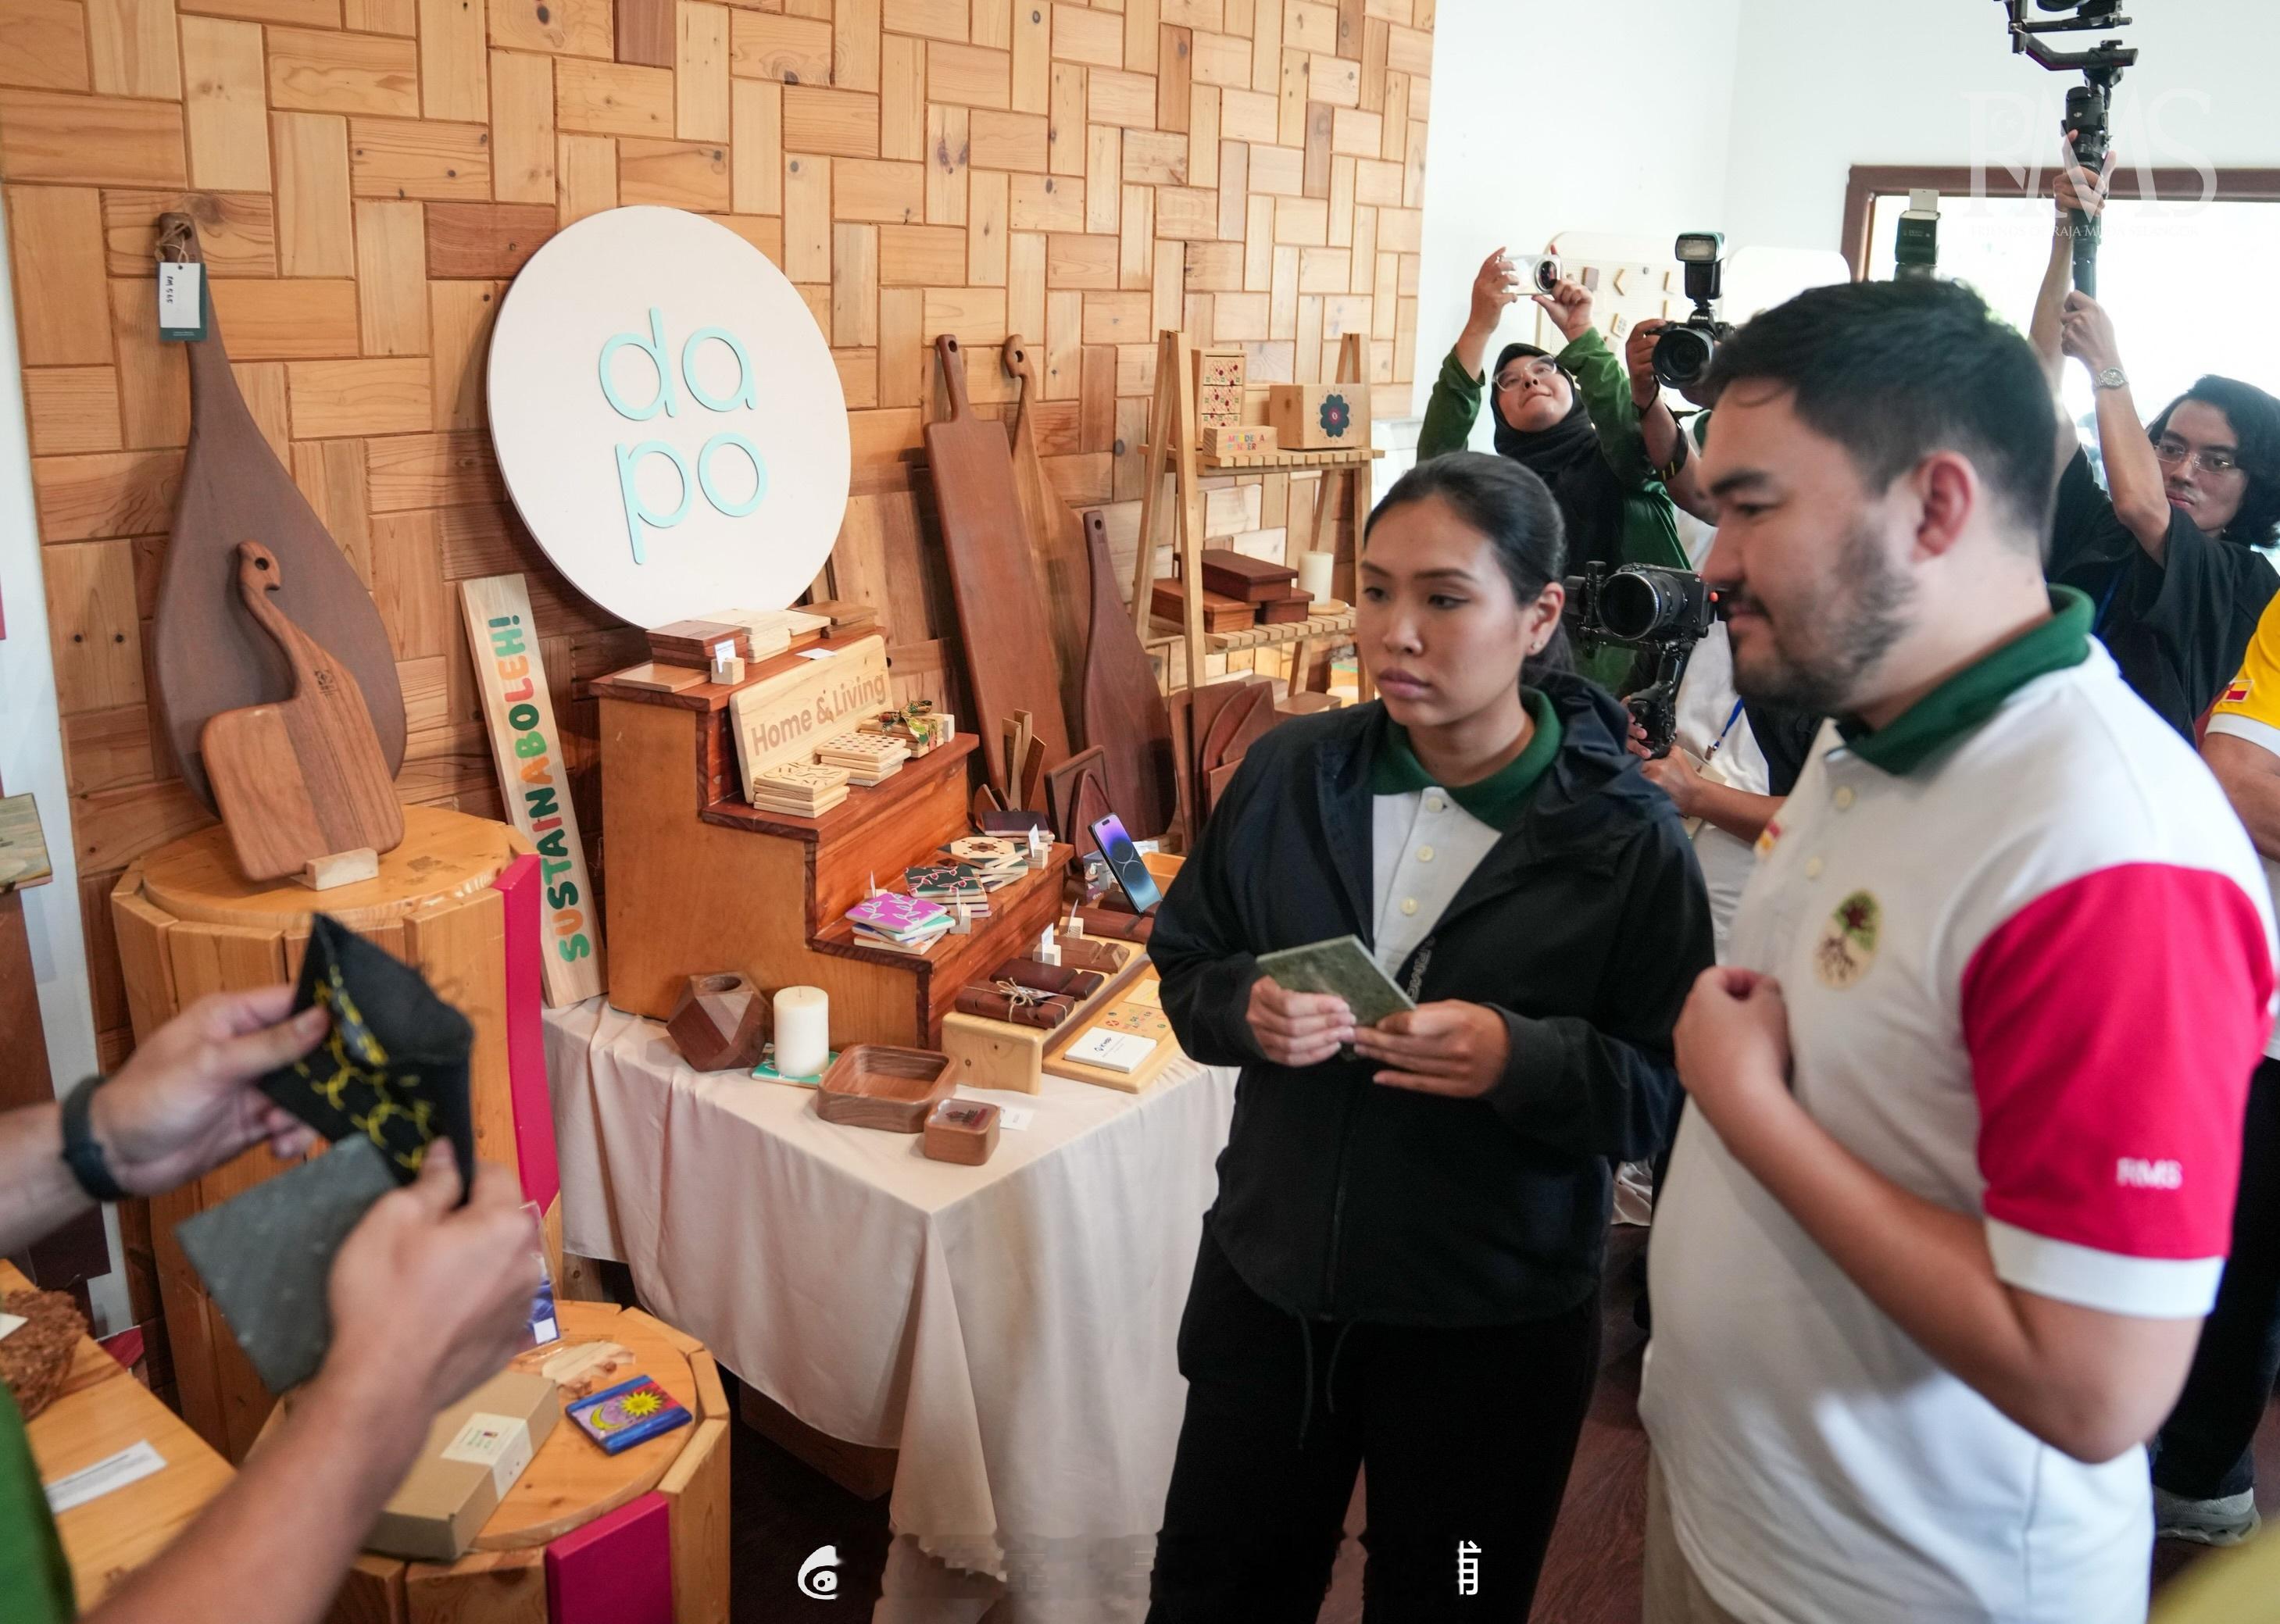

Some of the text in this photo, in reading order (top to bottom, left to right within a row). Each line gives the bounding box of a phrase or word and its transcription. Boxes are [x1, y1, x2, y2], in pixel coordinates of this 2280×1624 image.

[1228, 432, 1265, 443] MEDEA
[751, 674, 887, 756] Home & Living
[488, 614, 590, 962] SUSTAINABOLEH!
[2116, 1156, 2183, 1190] RMS
